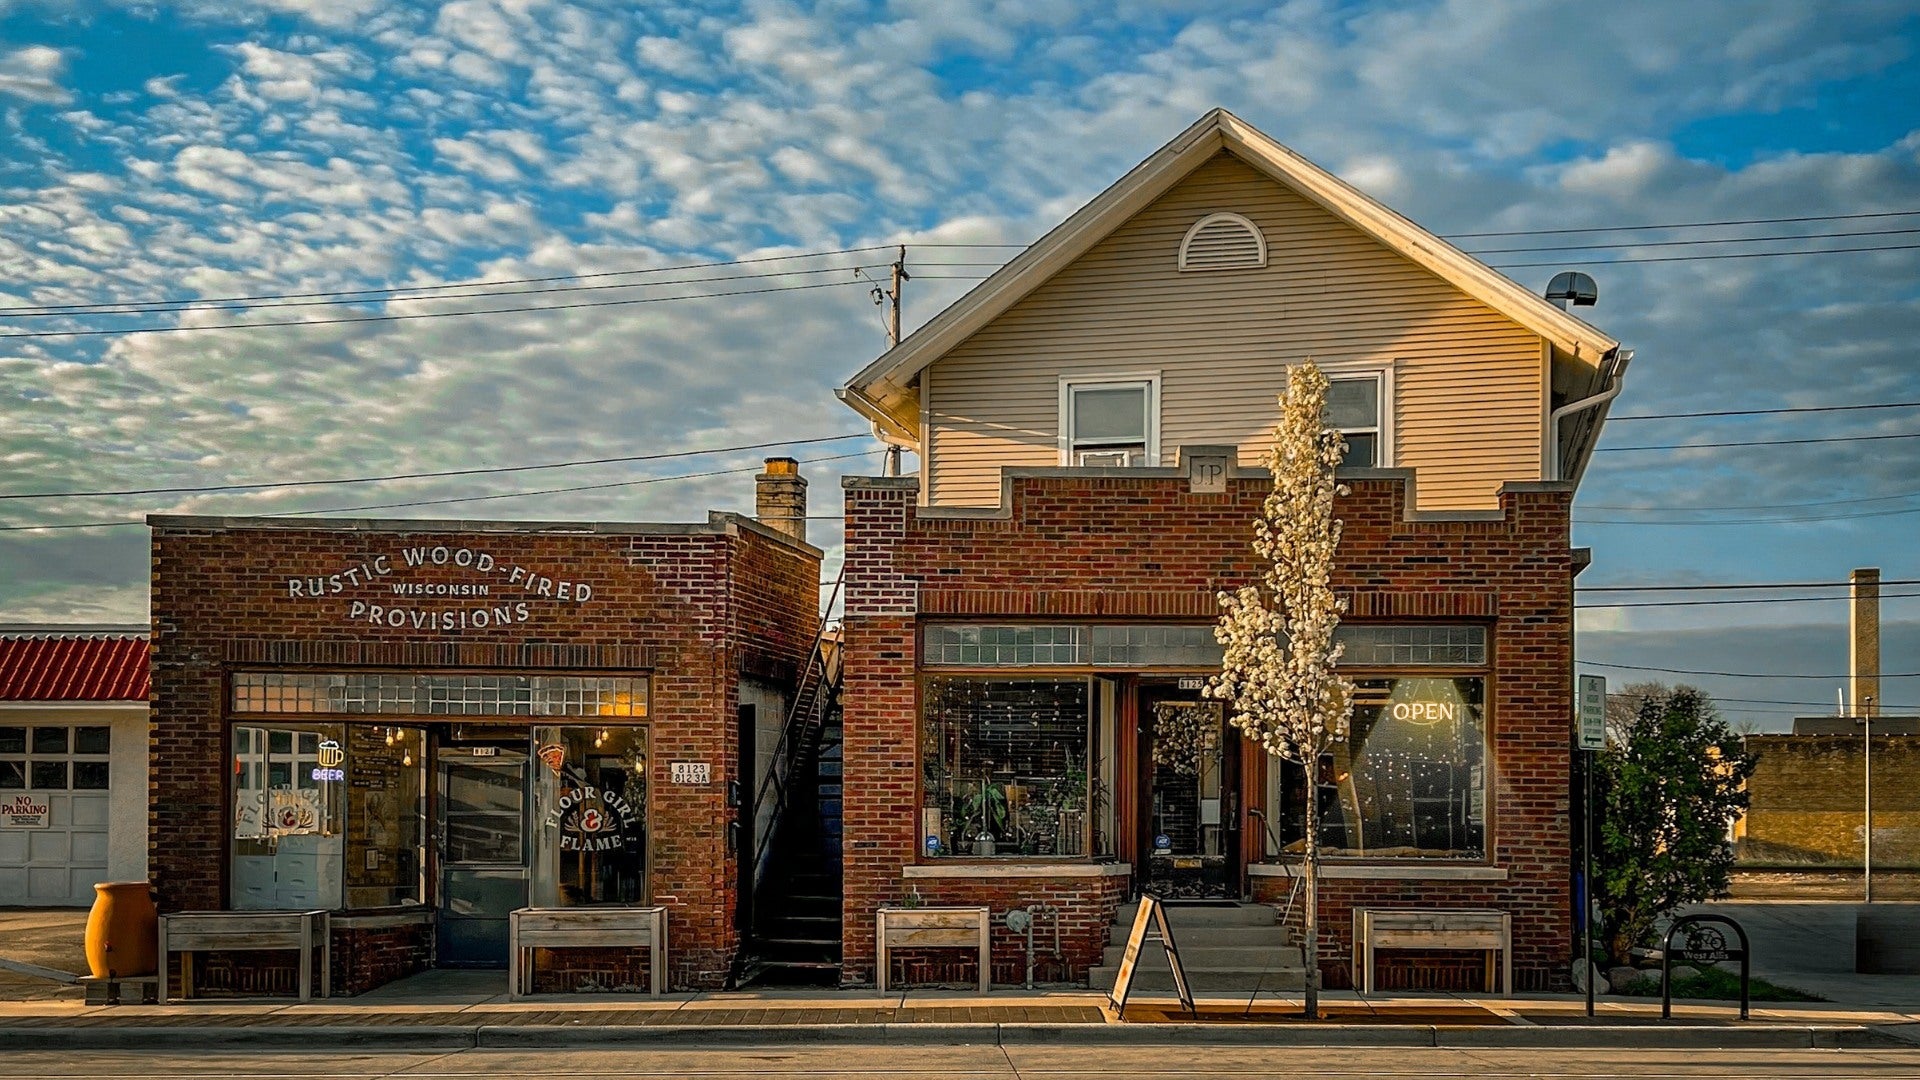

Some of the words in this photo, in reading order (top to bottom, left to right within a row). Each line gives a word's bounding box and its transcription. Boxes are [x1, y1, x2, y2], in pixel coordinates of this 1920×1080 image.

[1192, 464, 1225, 486] J.P.
[288, 555, 391, 598] RUSTIC
[402, 546, 592, 602] WOOD-FIRED
[392, 583, 489, 596] WISCONSIN
[350, 601, 530, 630] PROVISIONS
[1393, 702, 1454, 721] OPEN
[311, 768, 345, 781] BEER
[678, 764, 705, 774] 8123
[674, 773, 707, 783] 8123A
[15, 796, 32, 805] NO
[545, 786, 597, 828] FLOUR
[603, 790, 636, 828] GIRL
[2, 804, 47, 815] PARKING
[560, 835, 622, 851] FLAME
[1683, 951, 1707, 959] West
